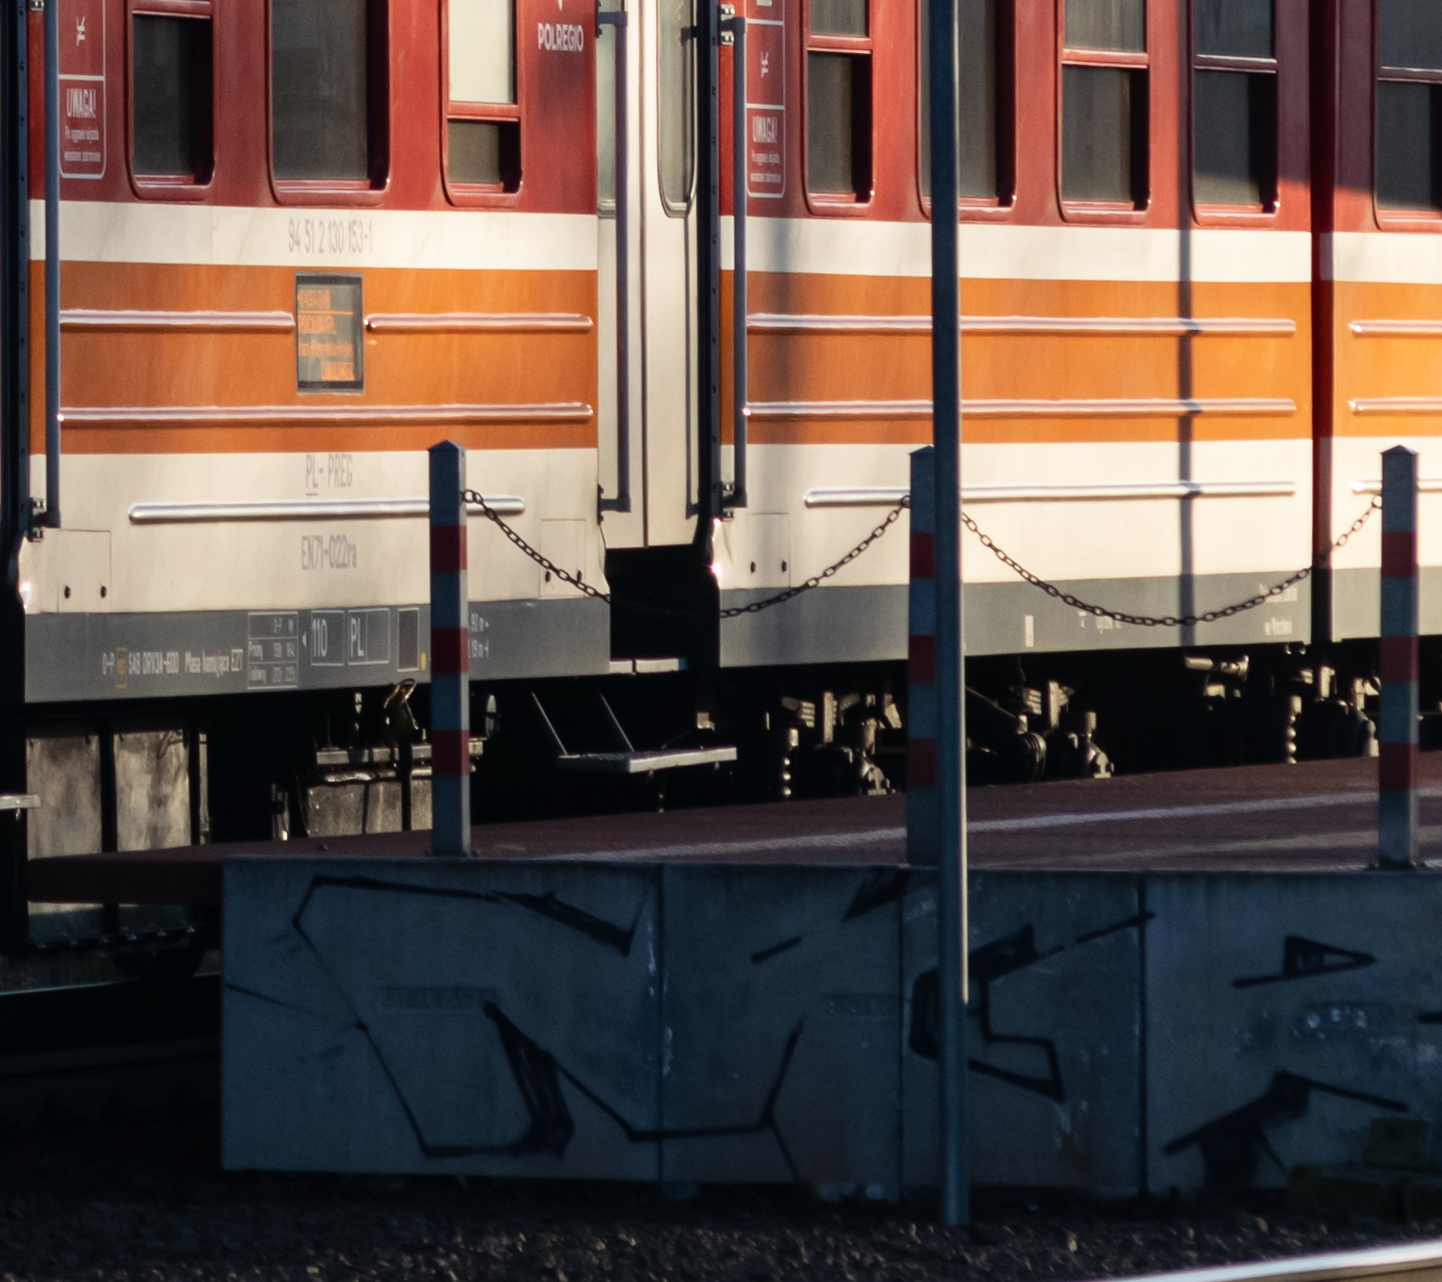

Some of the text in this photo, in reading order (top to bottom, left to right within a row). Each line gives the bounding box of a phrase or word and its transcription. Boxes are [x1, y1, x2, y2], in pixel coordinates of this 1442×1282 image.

[537, 22, 585, 53] POLREGIO
[66, 87, 97, 119] UWAGA!
[312, 618, 328, 658] 110
[350, 617, 365, 657] PL
